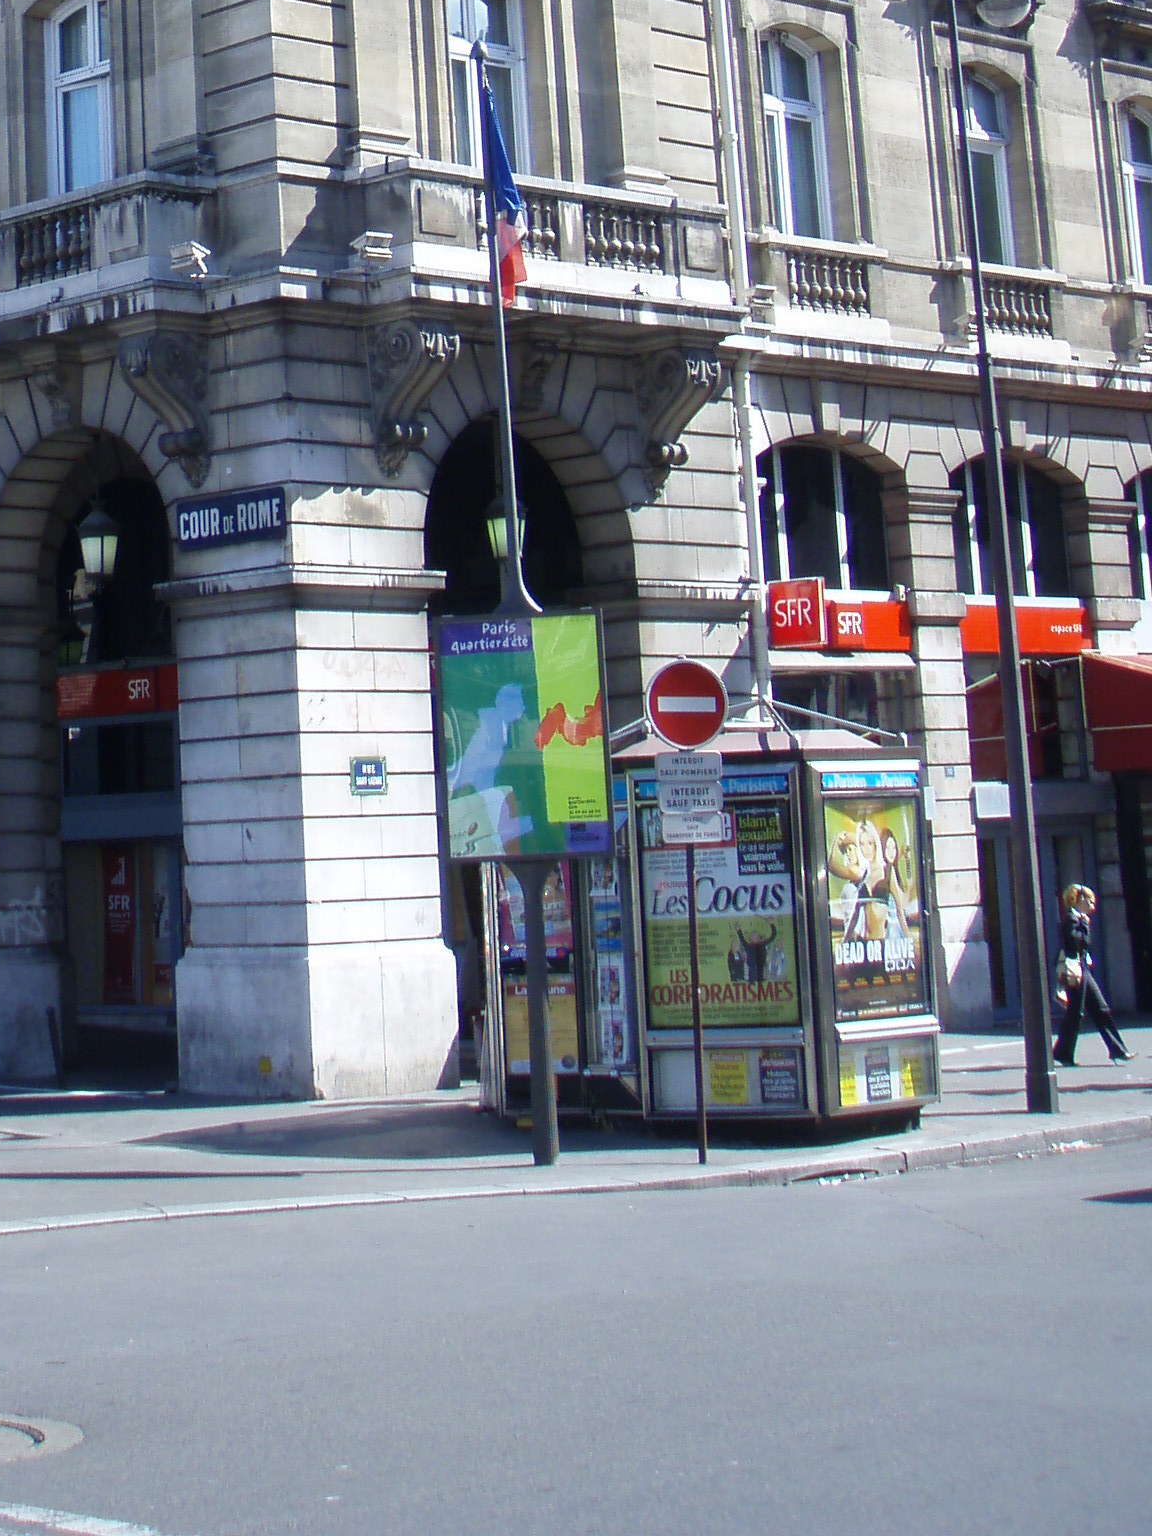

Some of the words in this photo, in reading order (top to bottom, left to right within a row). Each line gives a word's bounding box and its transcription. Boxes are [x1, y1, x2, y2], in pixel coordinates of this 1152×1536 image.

[179, 507, 221, 541] COUR
[223, 515, 235, 535] DE
[236, 497, 282, 532] ROME
[775, 597, 813, 628] SFR
[481, 620, 516, 635] Paris
[837, 611, 863, 635] SFR
[128, 679, 150, 699] SFR
[671, 757, 705, 765] INTERDIT
[659, 768, 678, 777] SAUF
[680, 767, 719, 776] POMPIERS
[670, 786, 710, 797] INTERDIT
[666, 799, 690, 809] SAUF
[692, 798, 717, 808] TAXIS
[738, 814, 767, 829] Islam
[108, 895, 130, 910] SFR
[651, 890, 688, 915] Les
[696, 877, 786, 913] Cocus
[835, 941, 865, 964] DEAD
[866, 940, 882, 962] OR
[884, 938, 915, 959] ALIVE
[669, 968, 689, 984] LES
